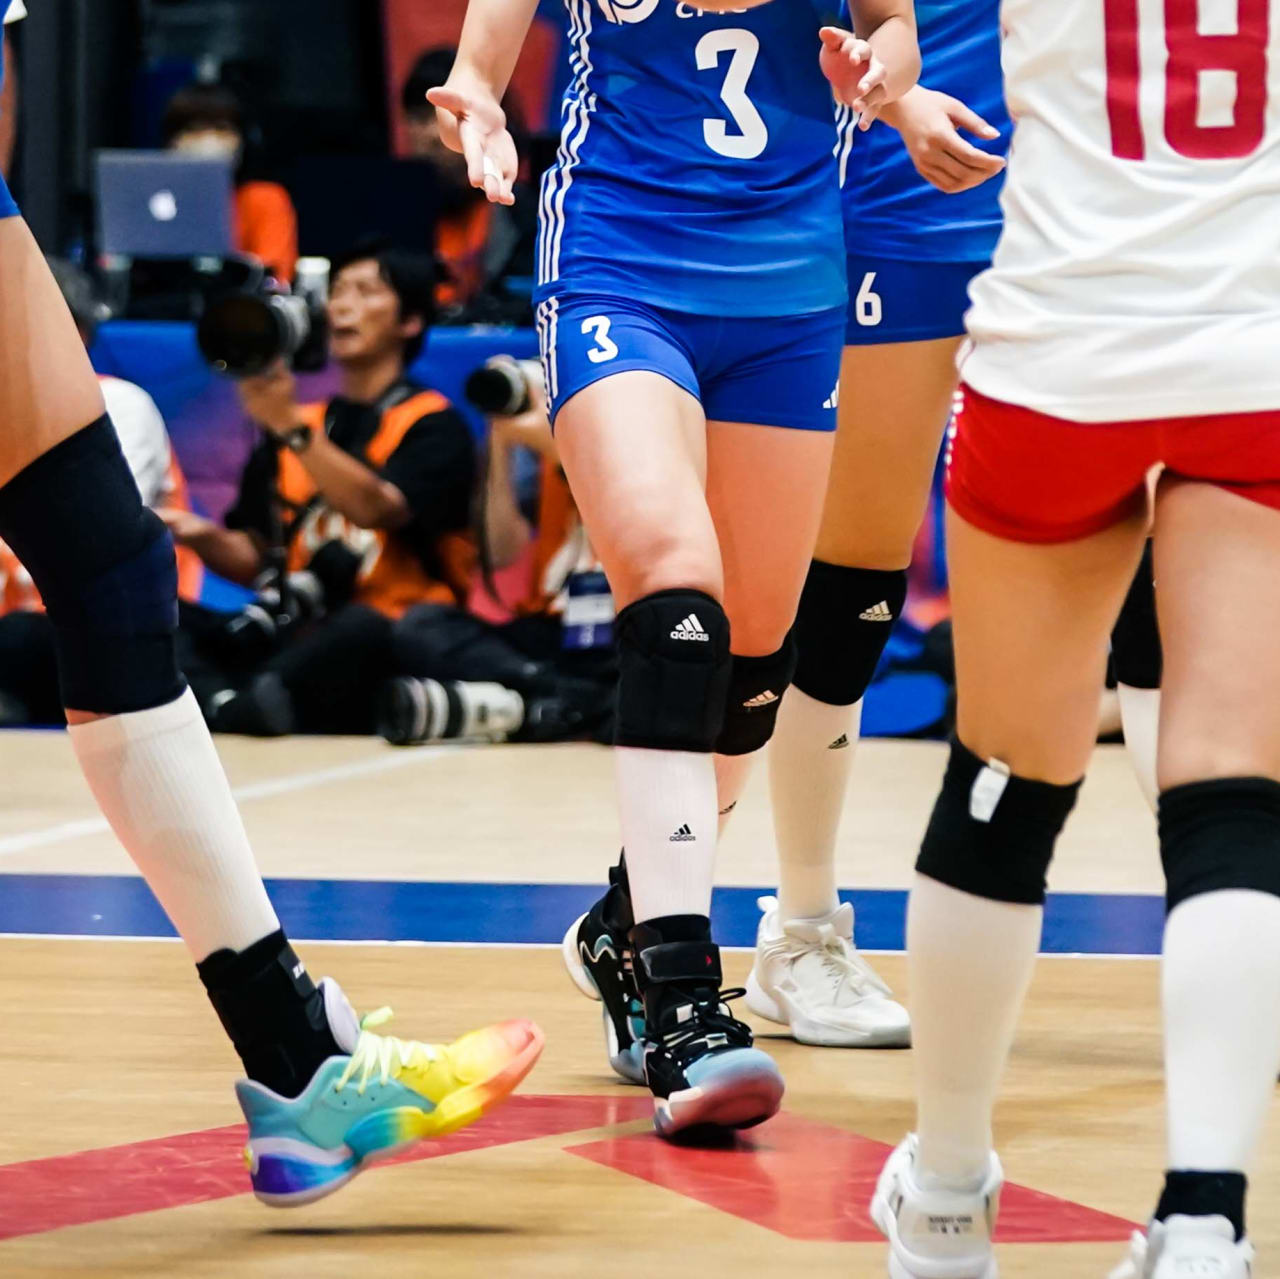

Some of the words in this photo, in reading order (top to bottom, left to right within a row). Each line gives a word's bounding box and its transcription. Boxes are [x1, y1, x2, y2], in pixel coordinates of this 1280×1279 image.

[694, 28, 768, 160] 3
[855, 271, 882, 326] 6
[580, 315, 619, 363] 3
[670, 628, 710, 642] adidas
